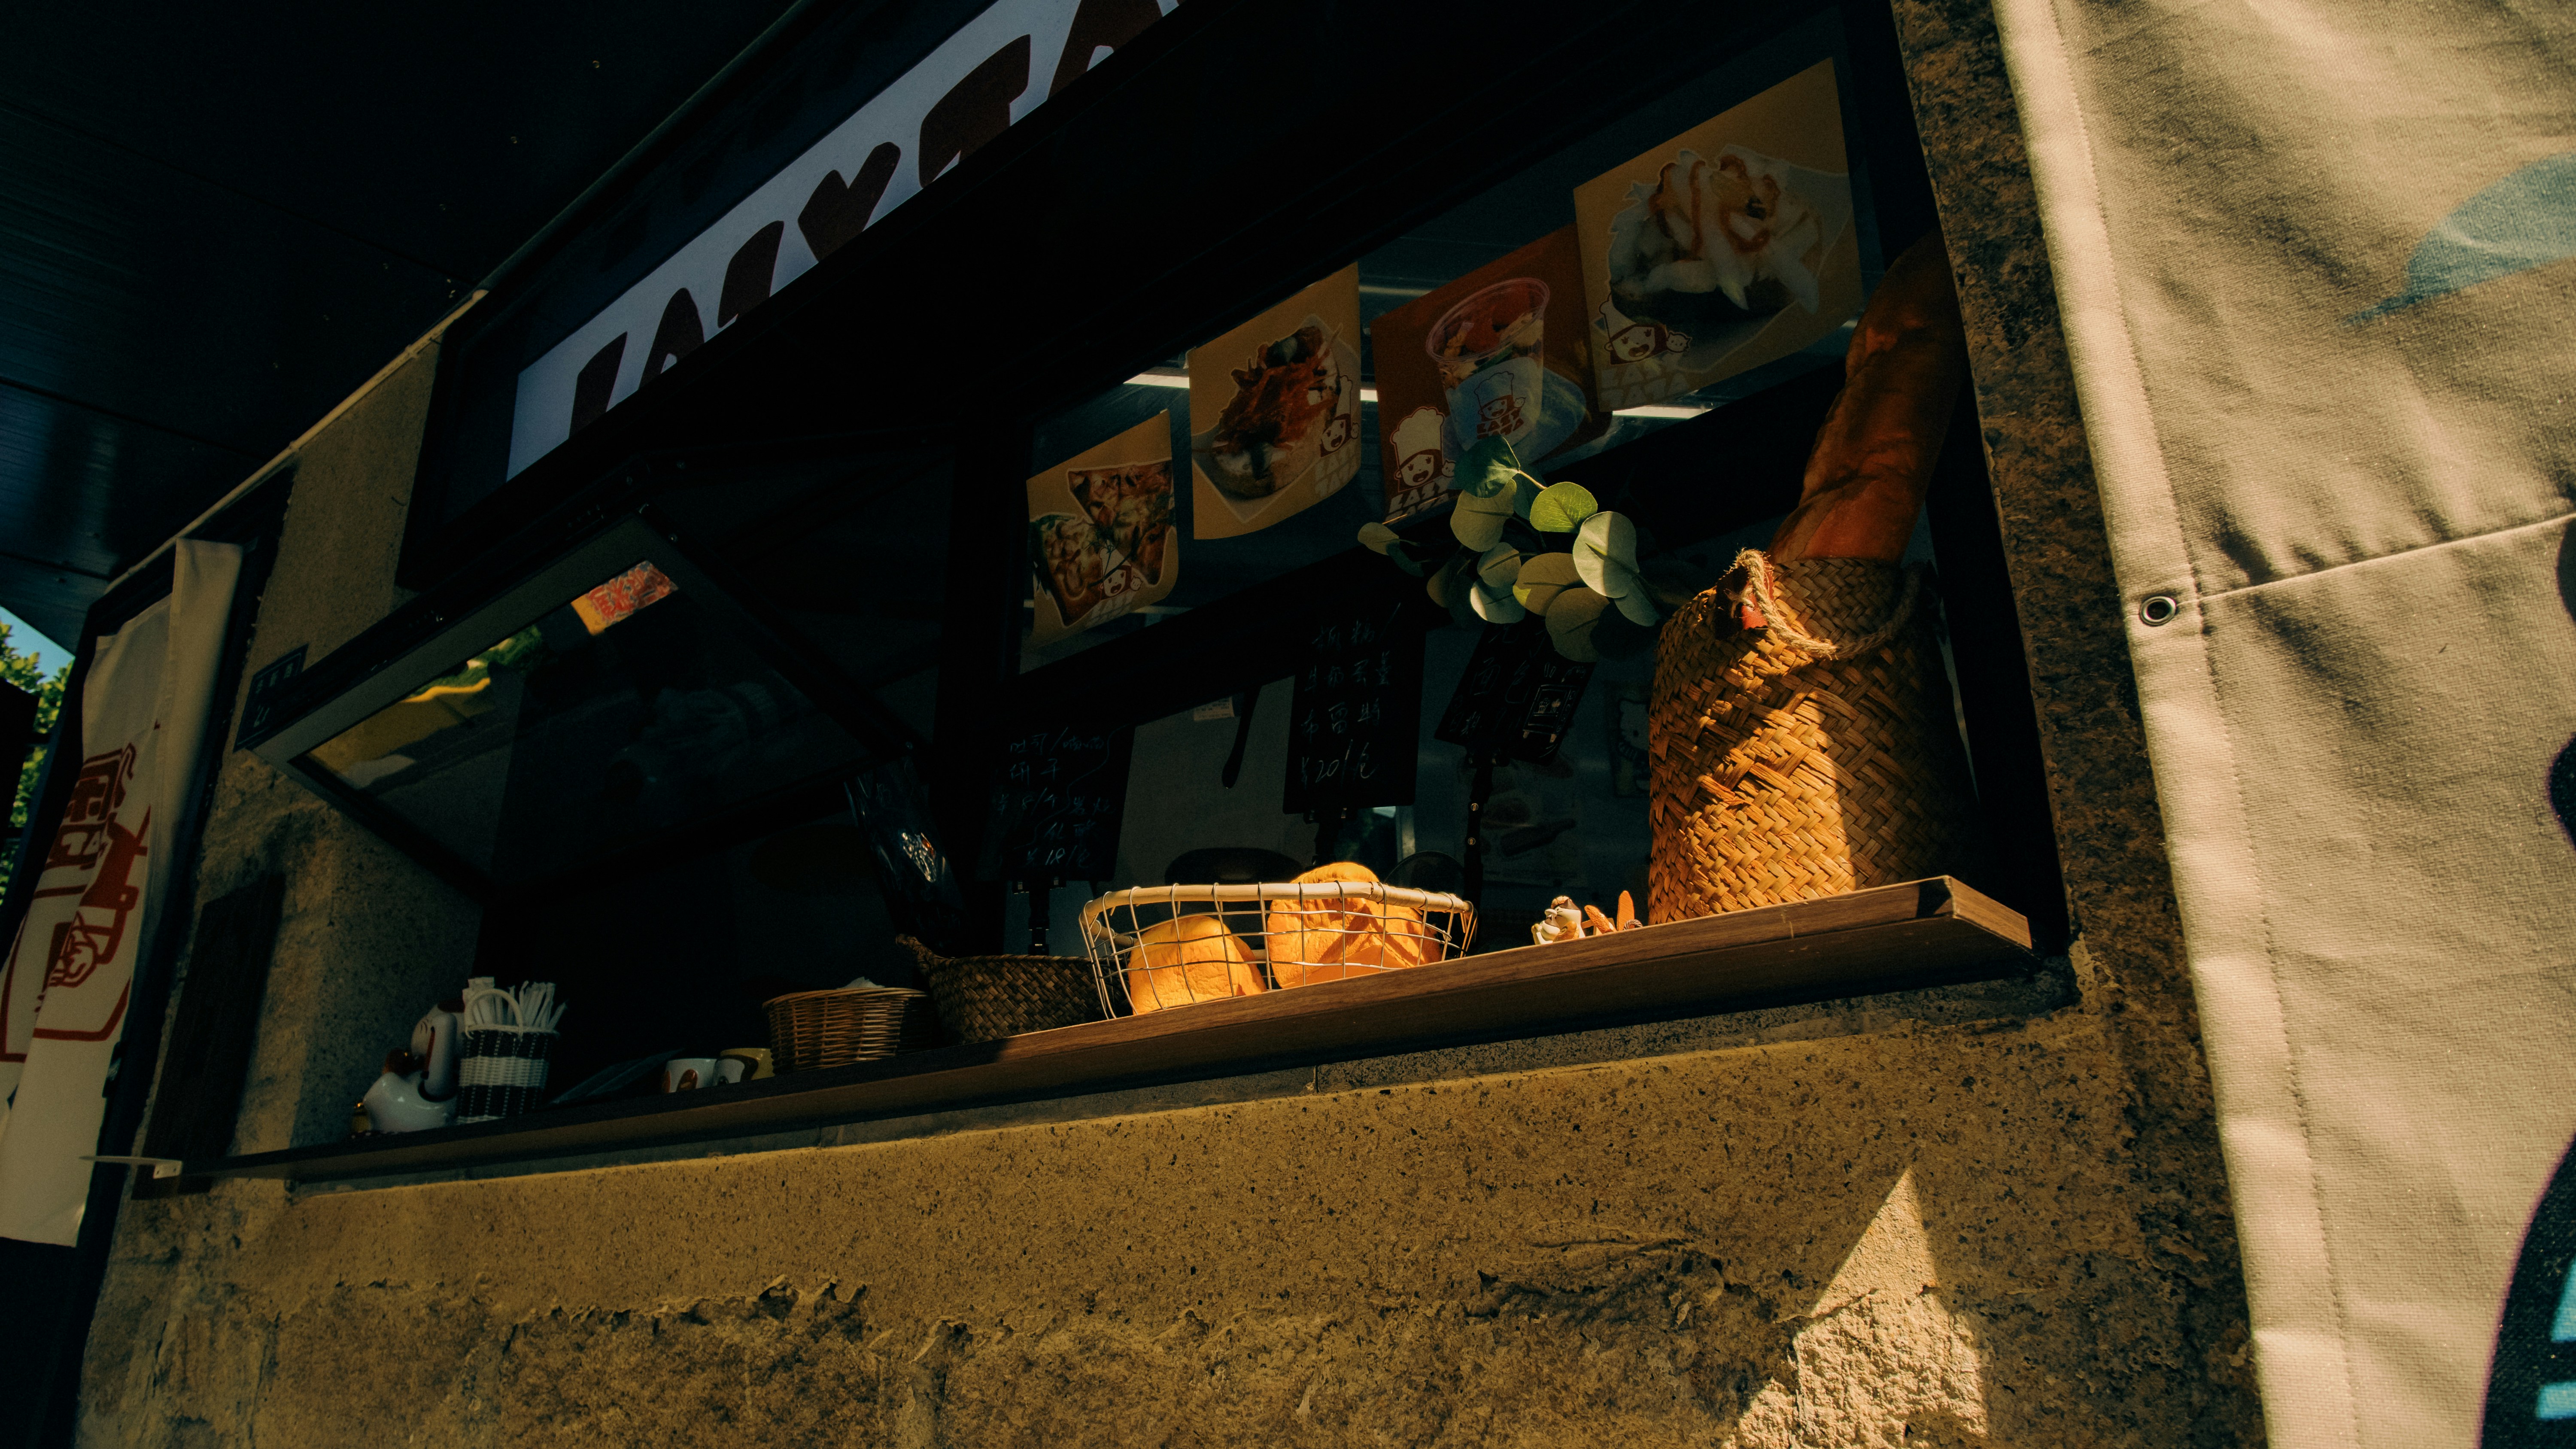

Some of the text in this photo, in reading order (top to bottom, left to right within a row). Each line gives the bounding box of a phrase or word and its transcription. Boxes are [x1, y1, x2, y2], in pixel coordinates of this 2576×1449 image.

[1477, 410, 1520, 433] LAZY
[1477, 418, 1524, 439] TA
[1388, 475, 1453, 514] LAZY
[1470, 657, 1532, 705] 面包
